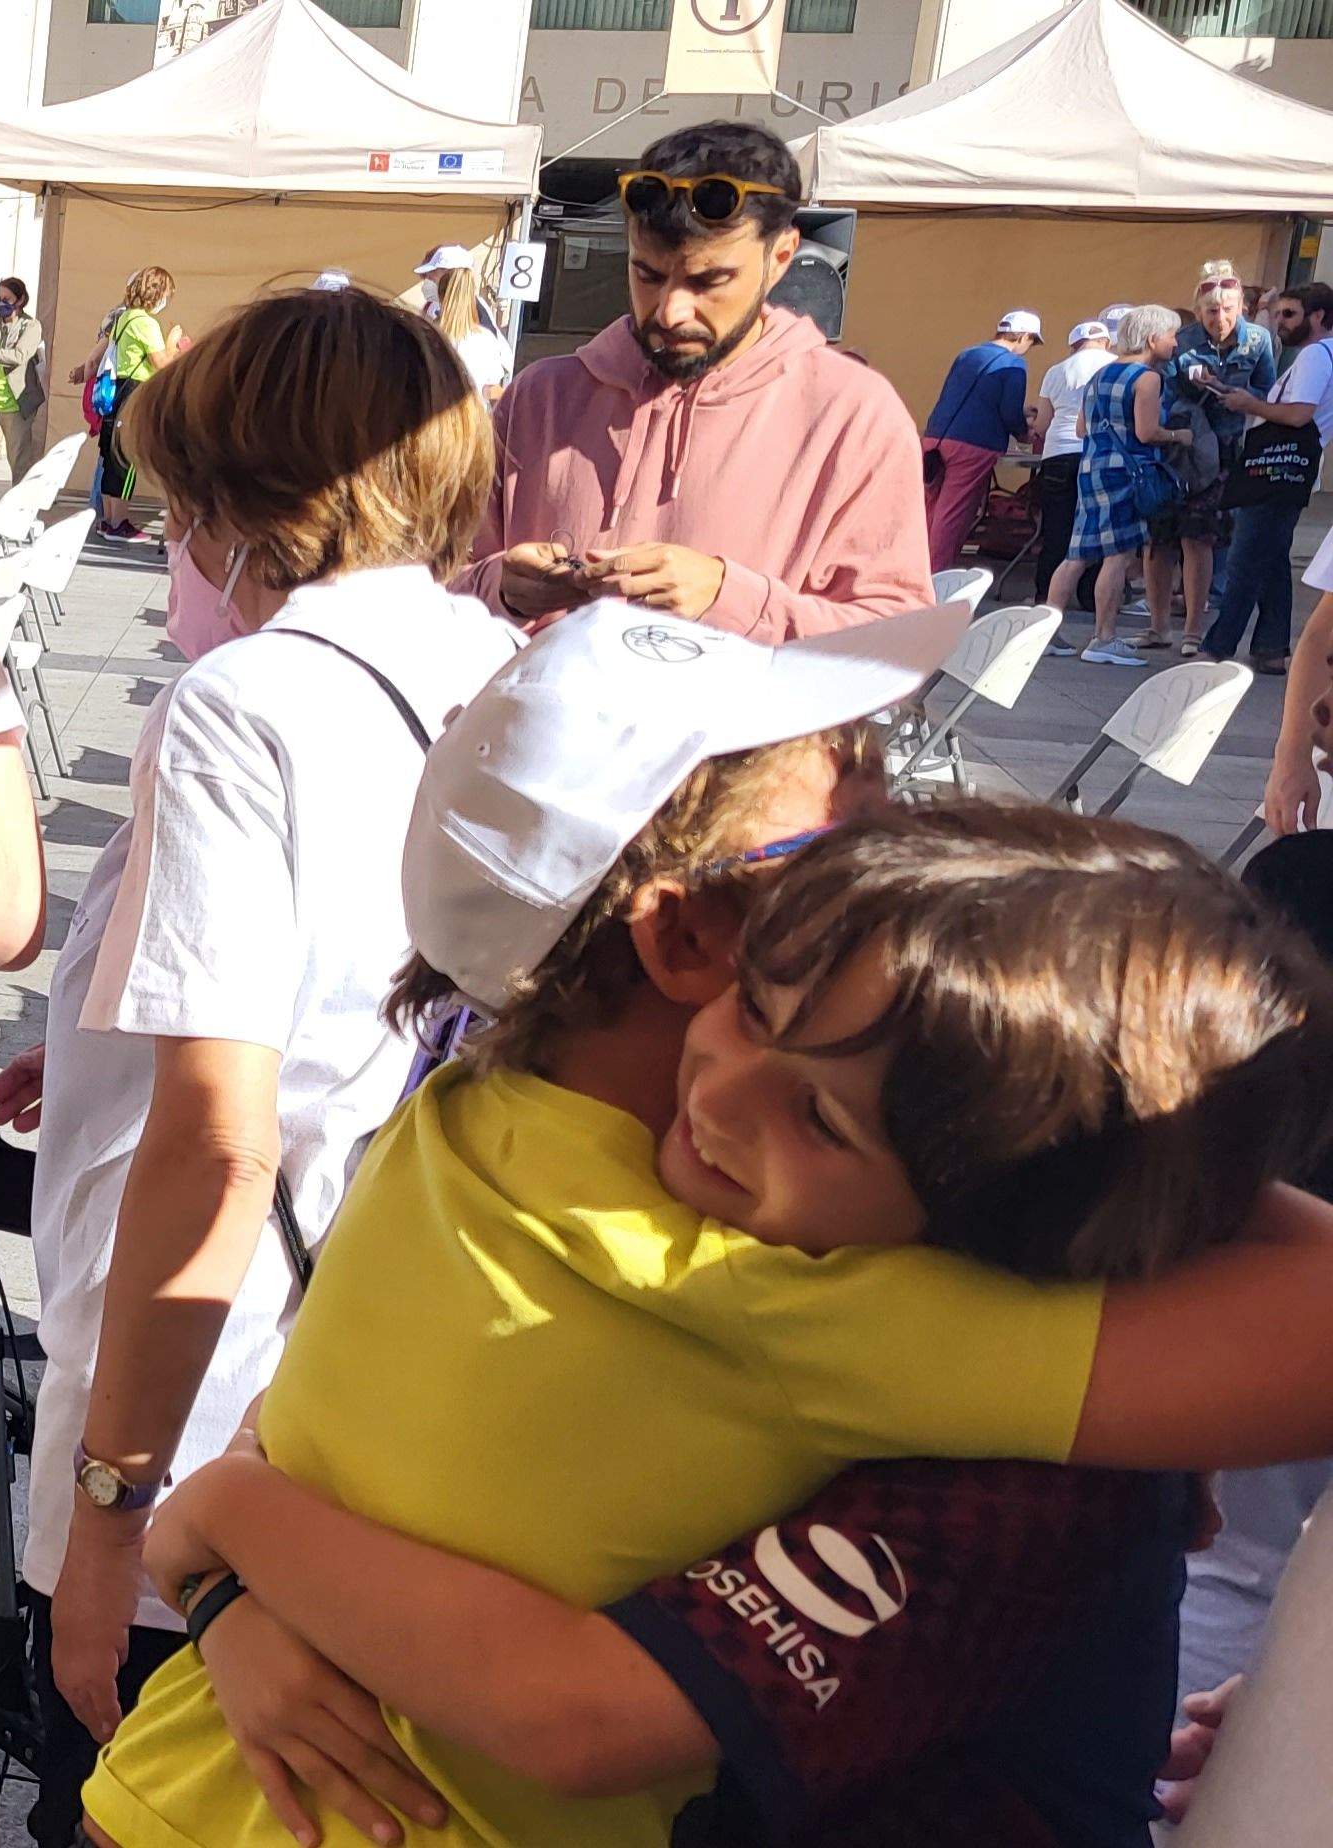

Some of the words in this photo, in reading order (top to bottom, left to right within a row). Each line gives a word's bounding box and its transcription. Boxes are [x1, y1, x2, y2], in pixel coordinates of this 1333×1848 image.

[592, 78, 670, 115] DE
[510, 255, 534, 289] 8
[1245, 454, 1310, 468] FORMANDO
[684, 1559, 841, 1711] OSEHISA
